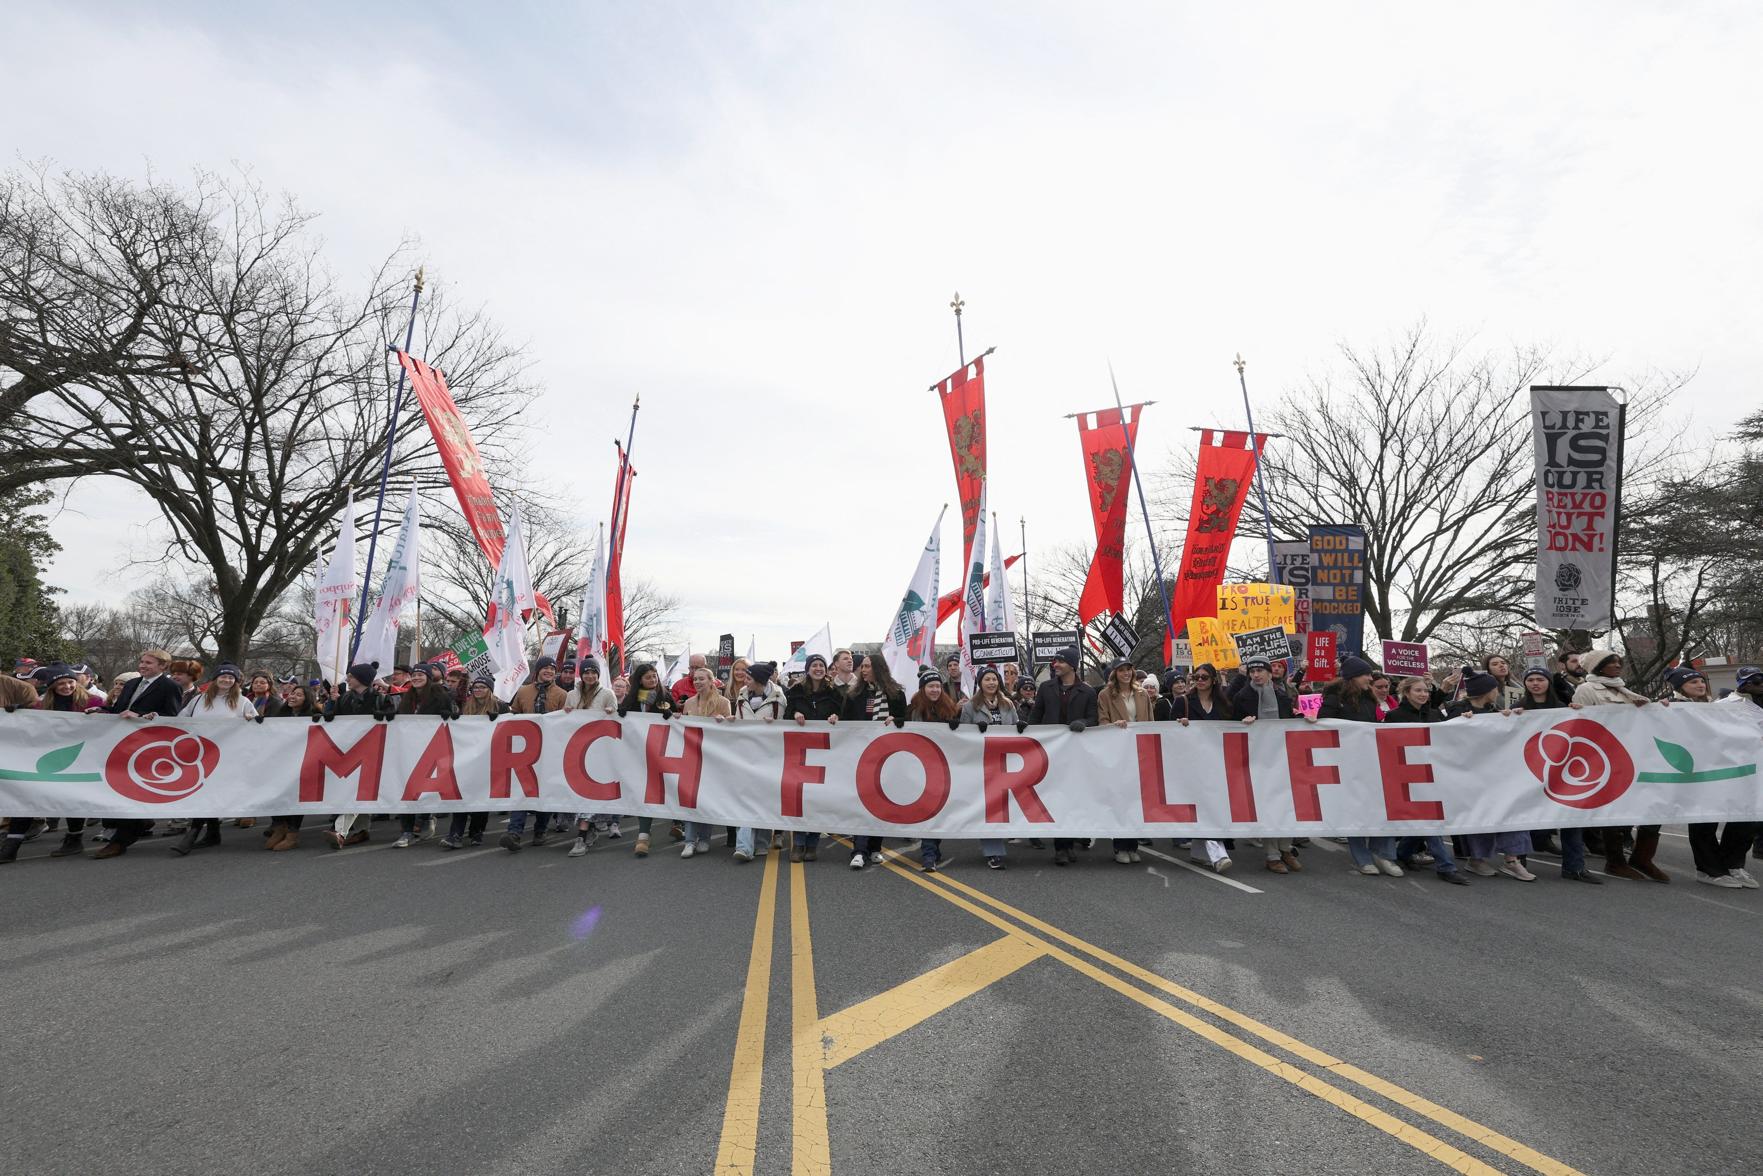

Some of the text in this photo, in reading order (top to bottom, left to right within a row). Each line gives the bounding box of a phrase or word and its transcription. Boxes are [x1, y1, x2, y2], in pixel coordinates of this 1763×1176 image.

[1540, 410, 1610, 430] LIFE
[1543, 431, 1610, 469] IS
[1543, 468, 1606, 490] OUR
[1545, 490, 1607, 510] REVO
[1546, 509, 1606, 532] LUT
[1312, 535, 1347, 550] GOD
[1545, 529, 1605, 553] ION!
[1321, 552, 1362, 567] WILL
[1317, 569, 1353, 583] NOT
[1221, 584, 1249, 596] PRO
[1259, 583, 1292, 595] LIFE
[1334, 585, 1358, 600] BE
[1219, 595, 1271, 611] IS TRUE
[1312, 602, 1361, 614] MOCKED
[1246, 636, 1261, 645] AM
[1264, 631, 1282, 641] THE
[1315, 637, 1329, 647] LIFE
[1238, 637, 1287, 656] PRO-LIFE
[1398, 648, 1420, 657] VOICE
[1314, 658, 1329, 668] Gift.
[1387, 659, 1425, 669] VOICELESS
[1300, 697, 1325, 711] DES
[298, 719, 1445, 825] MARCH FOR LIFE
